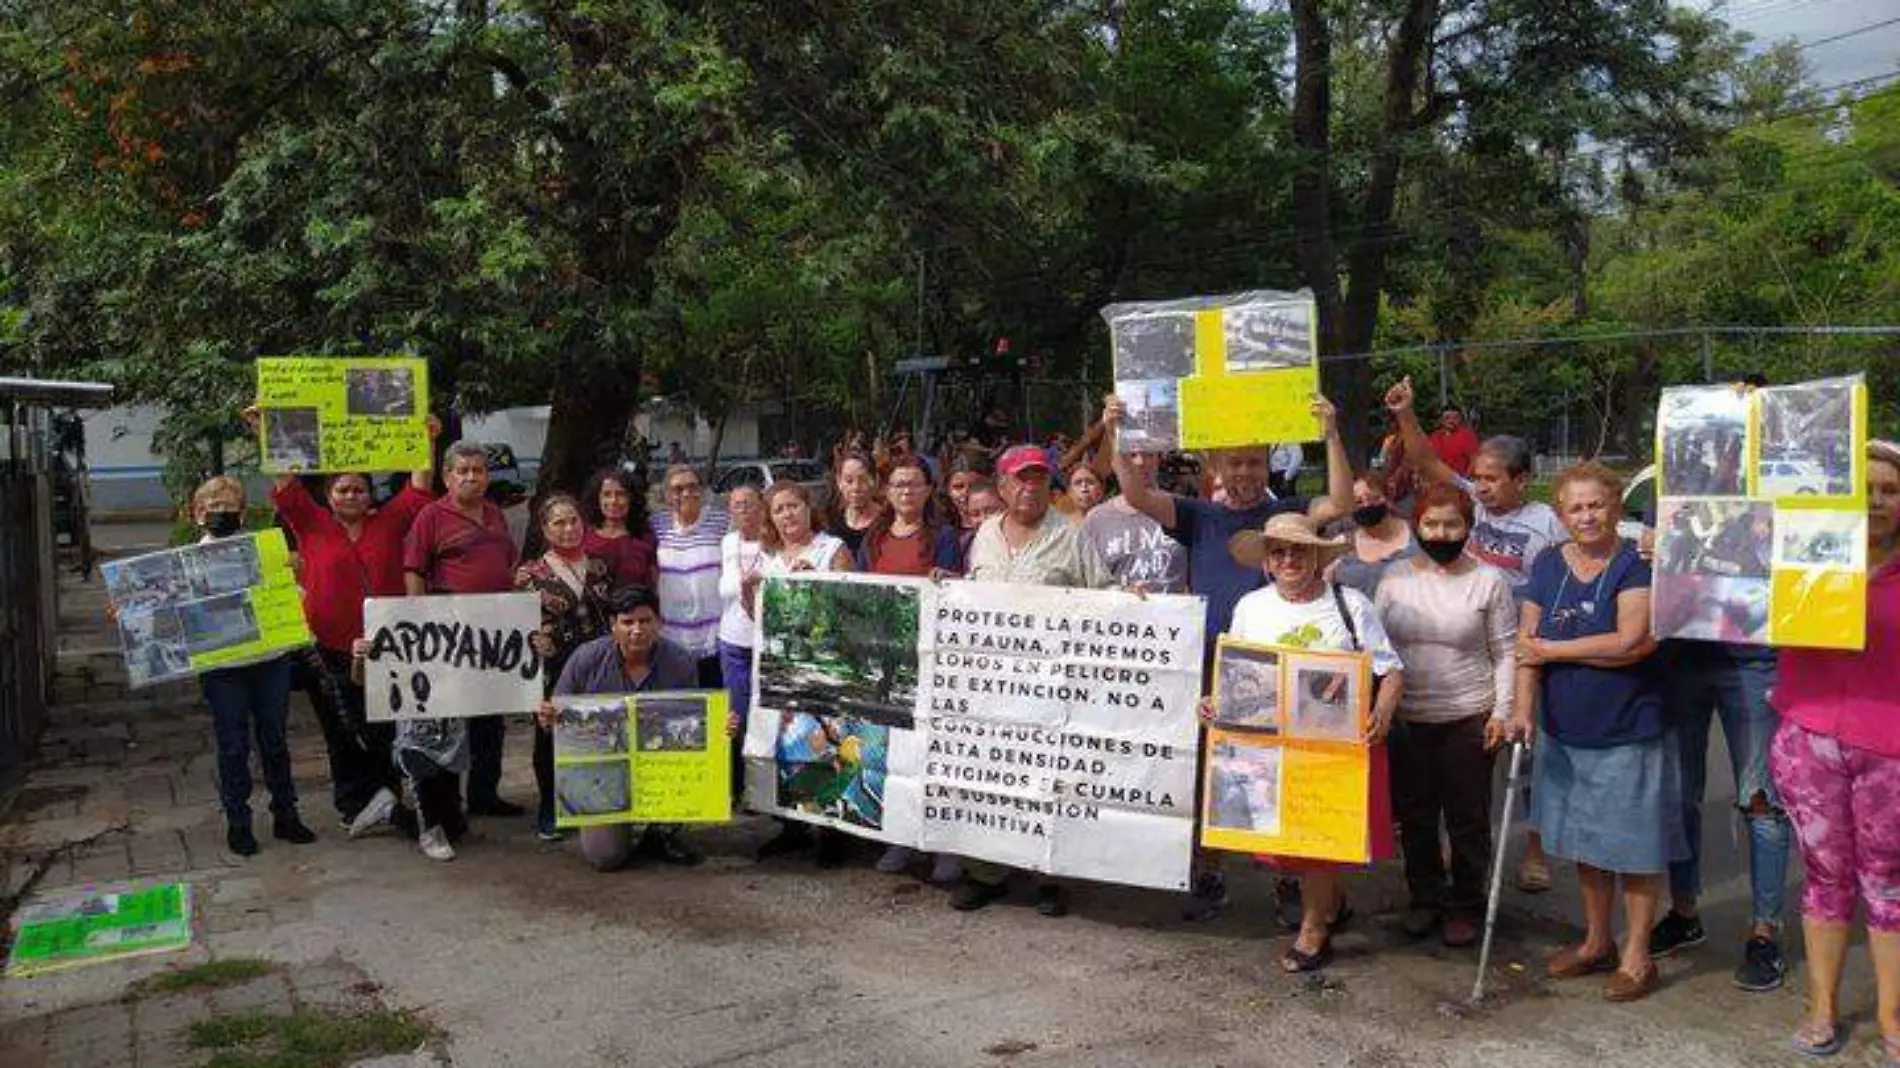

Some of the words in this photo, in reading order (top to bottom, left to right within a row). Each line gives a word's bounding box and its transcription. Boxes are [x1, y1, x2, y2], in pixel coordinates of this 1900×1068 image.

[937, 609, 1036, 629] PROTEGE
[1045, 614, 1071, 632] LA
[1081, 619, 1157, 640] FLORA
[1168, 627, 1181, 641] Y
[369, 621, 541, 680] APOYANOS
[936, 632, 959, 645] LA
[1062, 640, 1172, 665] TENEMOS
[1050, 662, 1150, 685] PELIGRO
[931, 699, 969, 713] LAS
[934, 675, 959, 689] DE
[1107, 692, 1139, 708] NO
[1151, 697, 1165, 711] A
[929, 739, 980, 758] ALTA
[931, 716, 1133, 755] CONSTRUCCIONES
[1143, 743, 1173, 760] DE
[925, 783, 949, 797] LA
[926, 762, 1030, 786] EXIGIMOS
[1075, 782, 1175, 807] CUMPLA
